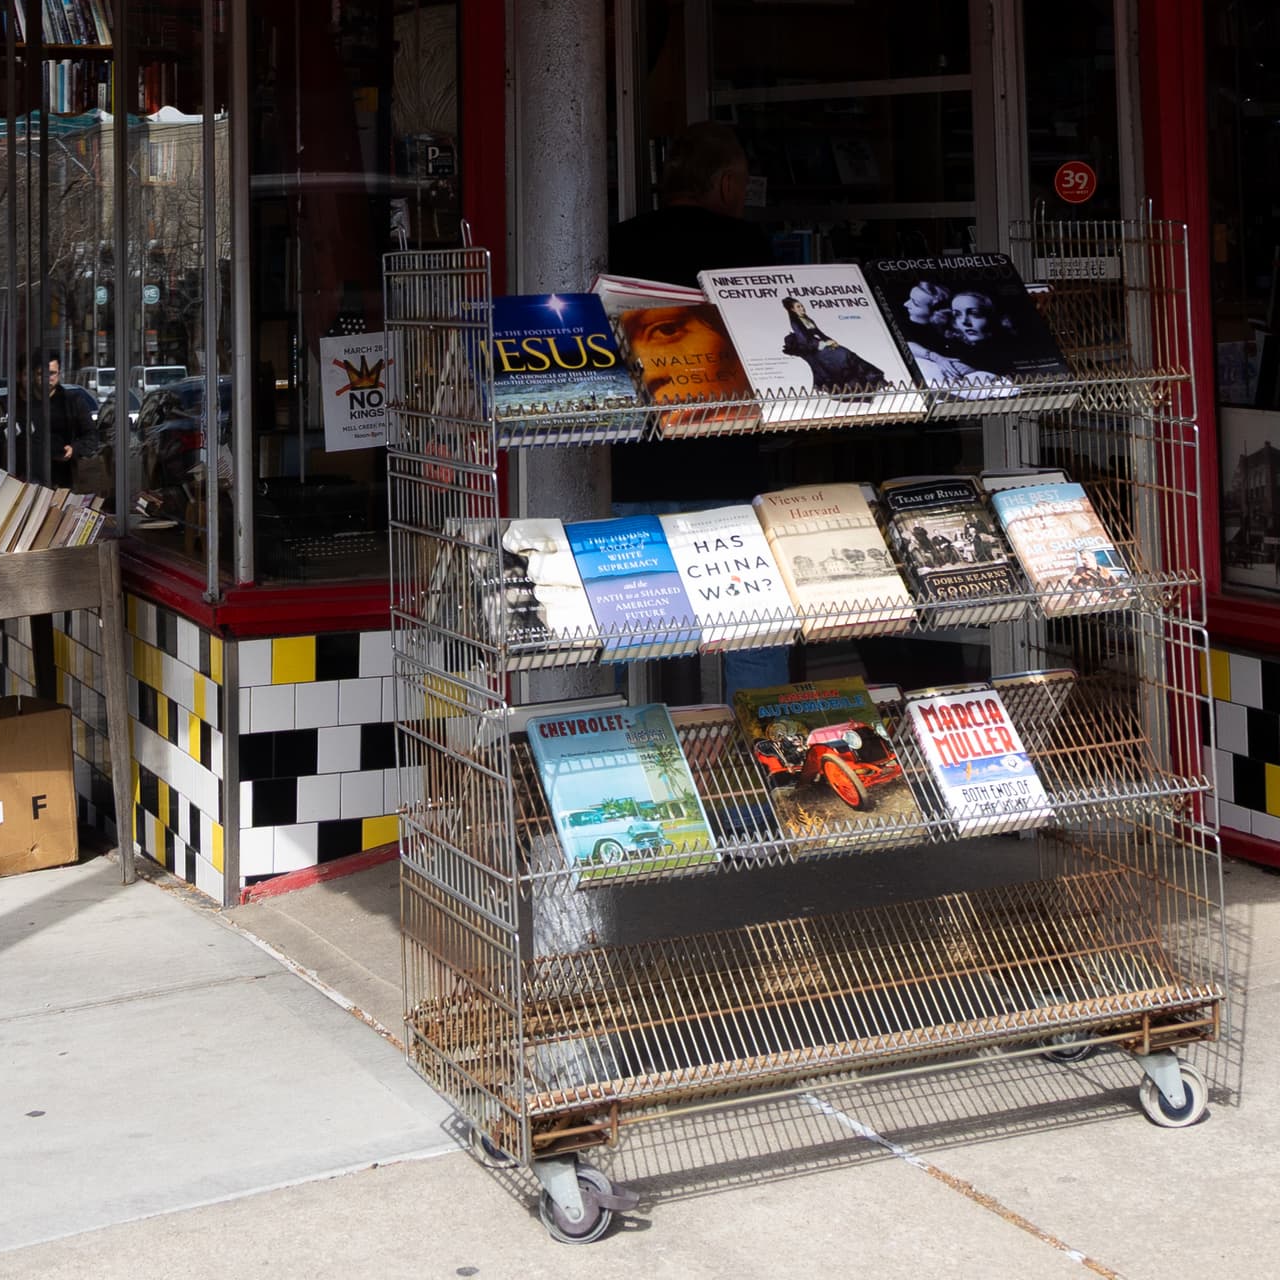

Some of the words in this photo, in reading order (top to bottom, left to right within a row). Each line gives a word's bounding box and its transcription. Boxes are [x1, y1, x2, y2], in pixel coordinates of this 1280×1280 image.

[1061, 169, 1089, 190] 39
[877, 258, 937, 272] GEORGE
[938, 254, 1008, 270] HURRELL'S
[711, 273, 795, 287] NINETEENTH
[718, 287, 779, 300] CENTURY
[787, 284, 864, 298] HUNGARIAN
[809, 297, 869, 310] PAINTING
[503, 329, 521, 337] THE
[523, 327, 570, 337] FOOTSTEPS
[572, 326, 585, 334] OF
[343, 346, 372, 355] MARCH
[349, 389, 384, 410] NO
[350, 407, 385, 421] KINGS
[768, 493, 809, 507] Views
[810, 491, 824, 502] of
[789, 504, 841, 520] Harvard
[693, 535, 744, 554] HAS
[1051, 535, 1106, 552] SHAPIRO
[607, 550, 643, 561] WHITE
[597, 558, 659, 573] SUPREMACY
[687, 555, 770, 579] CHINA
[932, 575, 964, 586] DORIS
[966, 569, 1007, 581] KEARNS
[640, 586, 681, 598] SHARED
[615, 597, 670, 612] AMERICAN
[624, 608, 667, 620] FUTURE
[758, 695, 865, 719] AUTOMOBILE
[917, 698, 1006, 734] MARCIA
[538, 714, 632, 739] CHEVROLET:
[932, 726, 1018, 769] MULLER
[961, 785, 988, 803] BOTH
[31, 794, 48, 820] F
